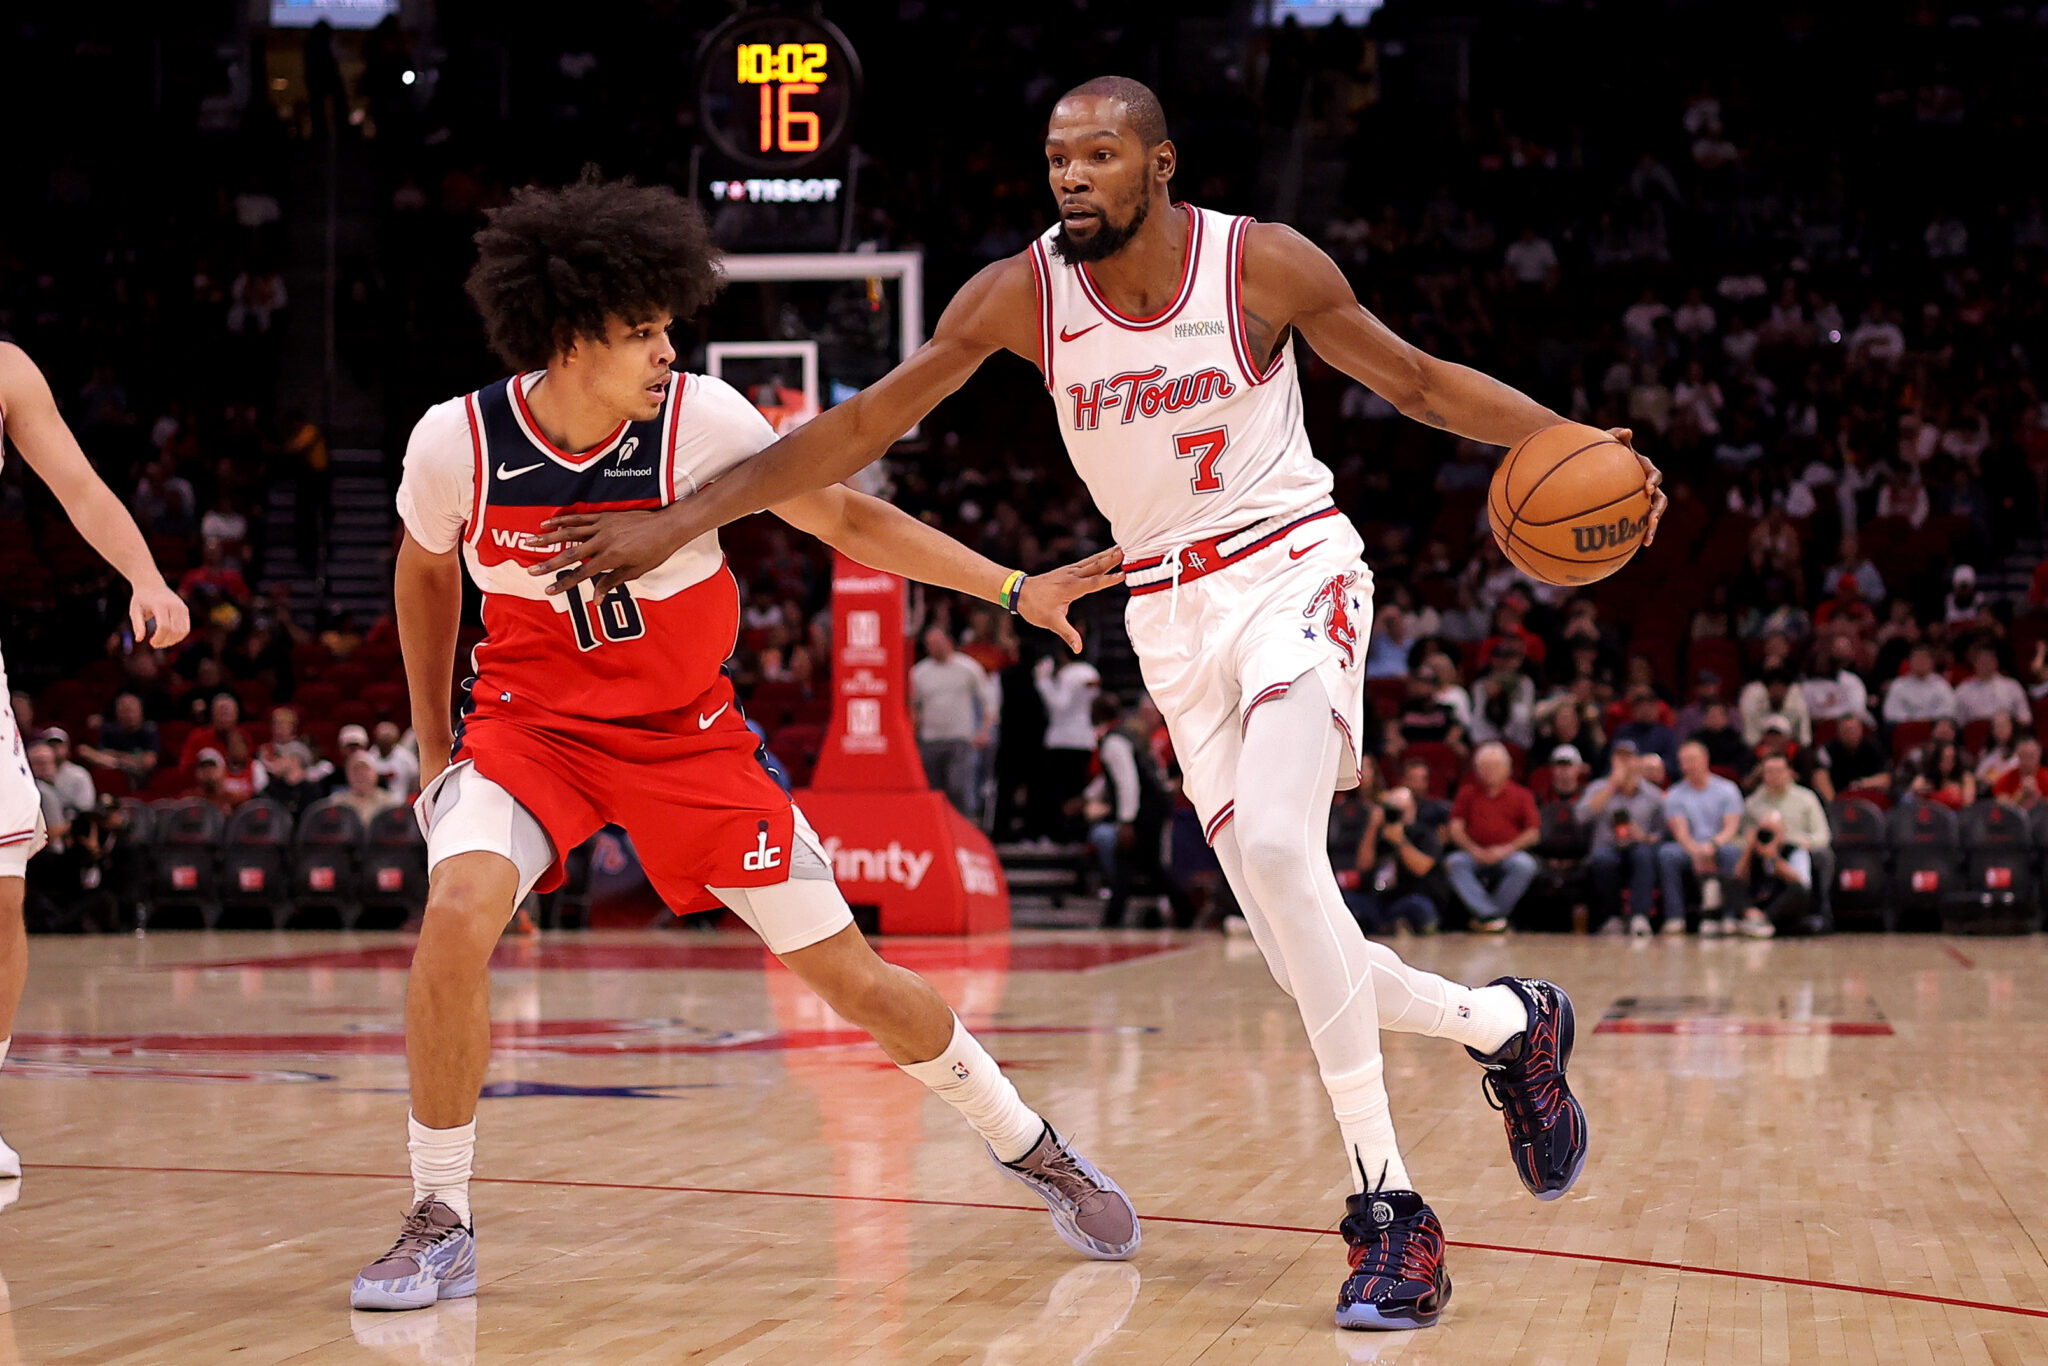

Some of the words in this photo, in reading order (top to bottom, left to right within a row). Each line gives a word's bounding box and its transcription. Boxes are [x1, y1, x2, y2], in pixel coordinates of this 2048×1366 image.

[737, 43, 828, 84] 10:02
[760, 83, 820, 152] 16
[1175, 320, 1224, 331] MEMORIAL
[1175, 327, 1224, 338] HERMANN
[1066, 365, 1236, 430] H-Town
[603, 466, 652, 478] Robinhood
[1173, 424, 1230, 495] 7
[1571, 514, 1650, 553] Wilso
[555, 568, 646, 653] 18
[823, 836, 934, 890] finity
